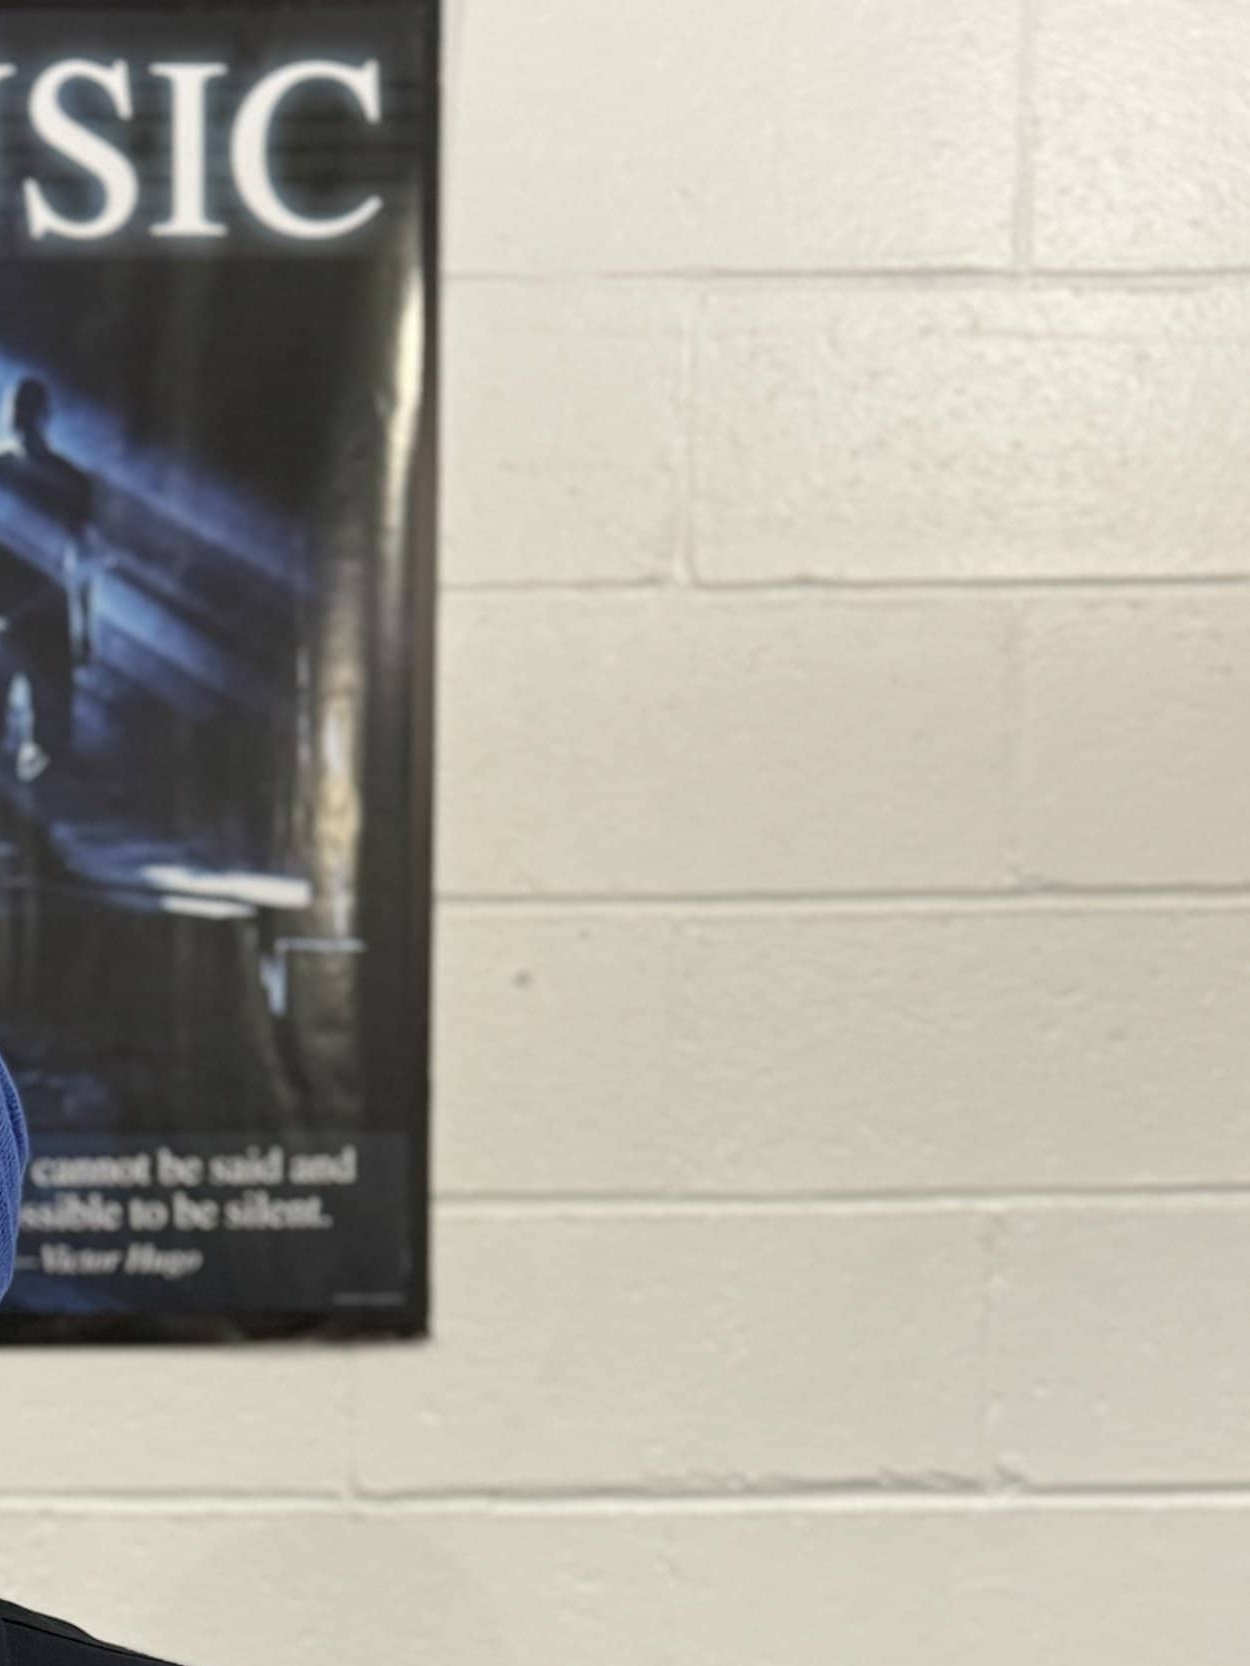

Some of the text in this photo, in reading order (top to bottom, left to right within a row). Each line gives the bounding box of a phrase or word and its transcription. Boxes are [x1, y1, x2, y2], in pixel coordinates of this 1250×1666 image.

[31, 1145, 357, 1188] cannot be said and
[129, 1197, 168, 1230] to
[173, 1190, 219, 1230] be
[225, 1190, 333, 1229] silent.
